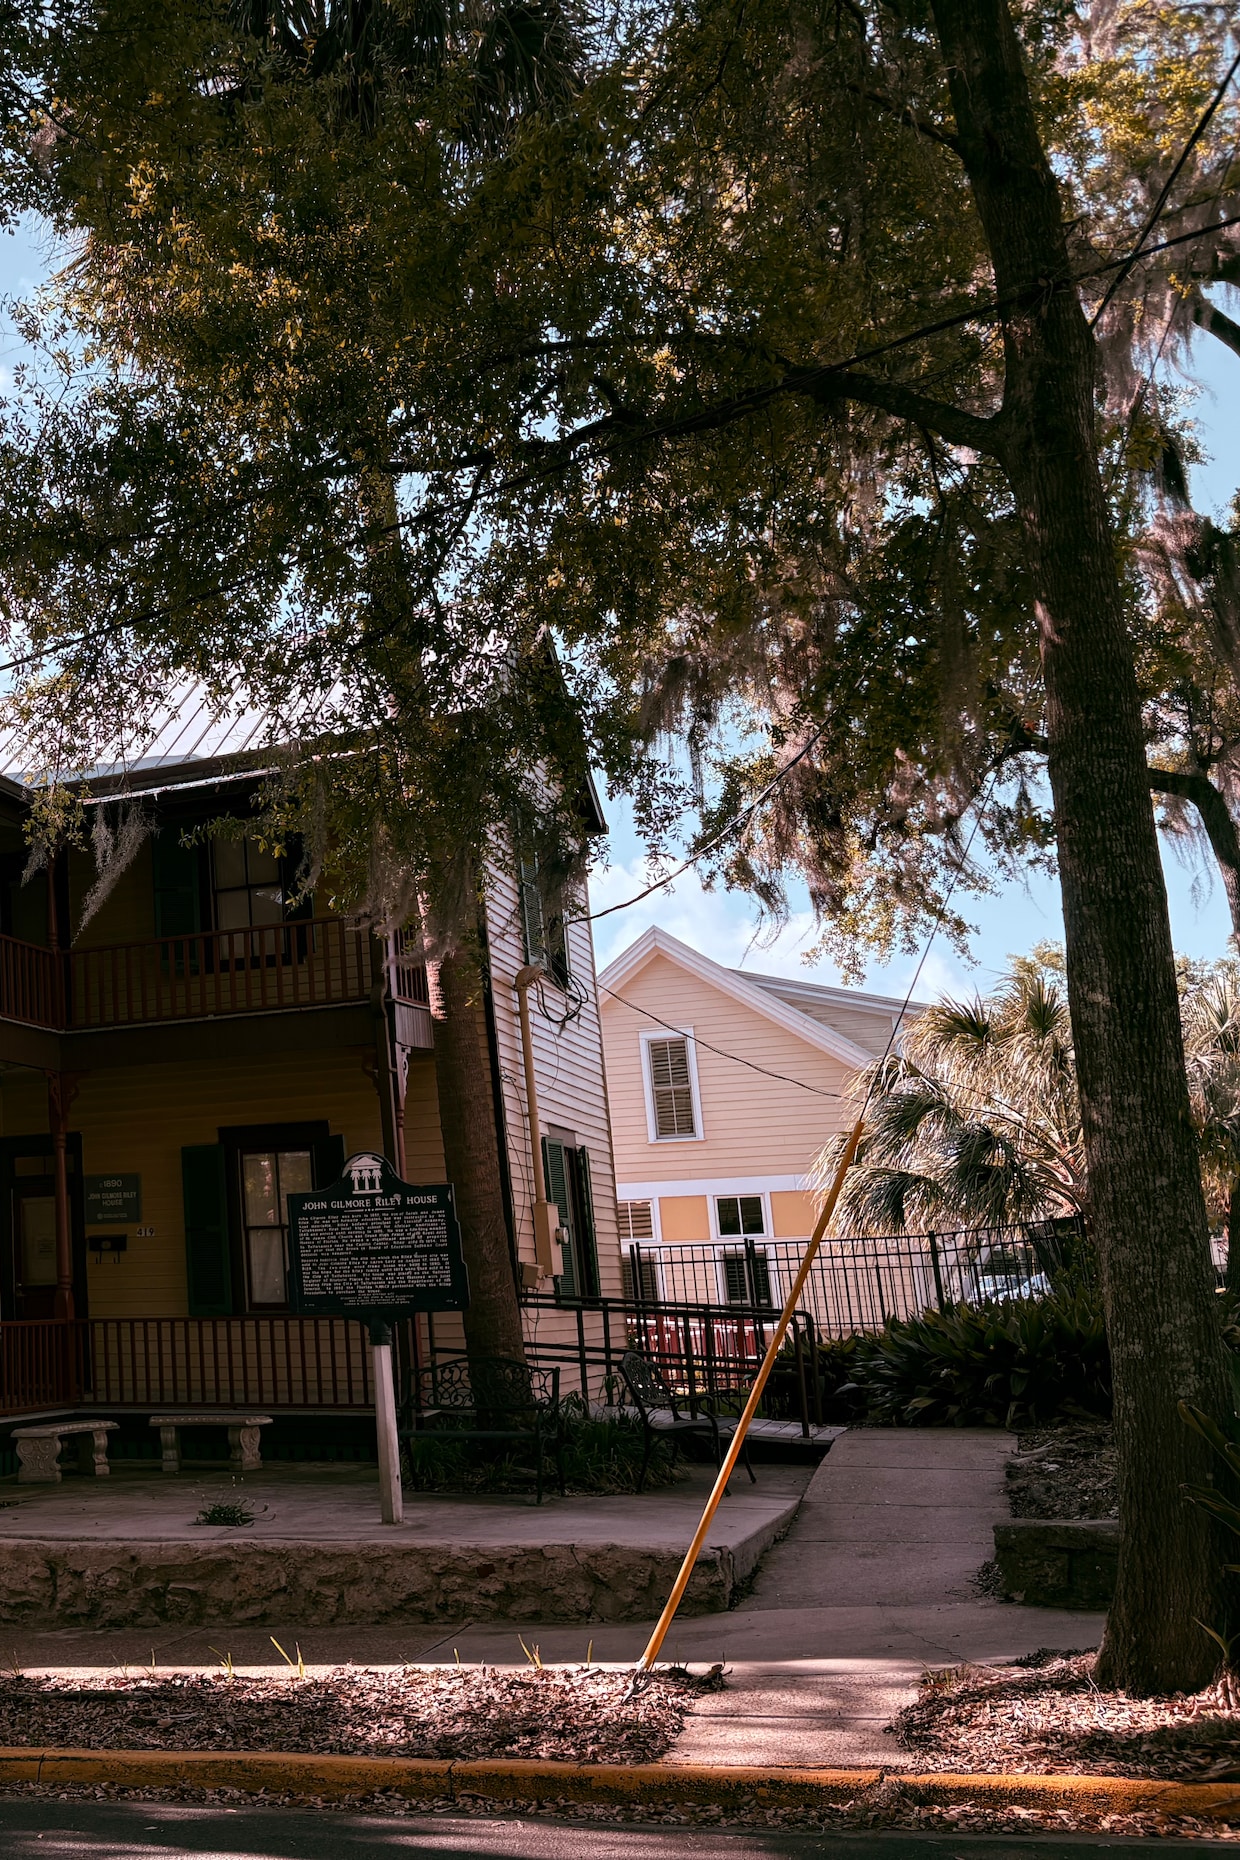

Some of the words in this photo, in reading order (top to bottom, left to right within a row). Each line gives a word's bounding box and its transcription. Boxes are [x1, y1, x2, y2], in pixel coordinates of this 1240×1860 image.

[104, 1179, 122, 1188] 1890
[302, 1202, 327, 1210] JOHN
[331, 1199, 371, 1209] GILMORE
[375, 1197, 401, 1206] RILEY
[406, 1195, 438, 1204] HOUSE
[138, 1227, 154, 1236] 419
